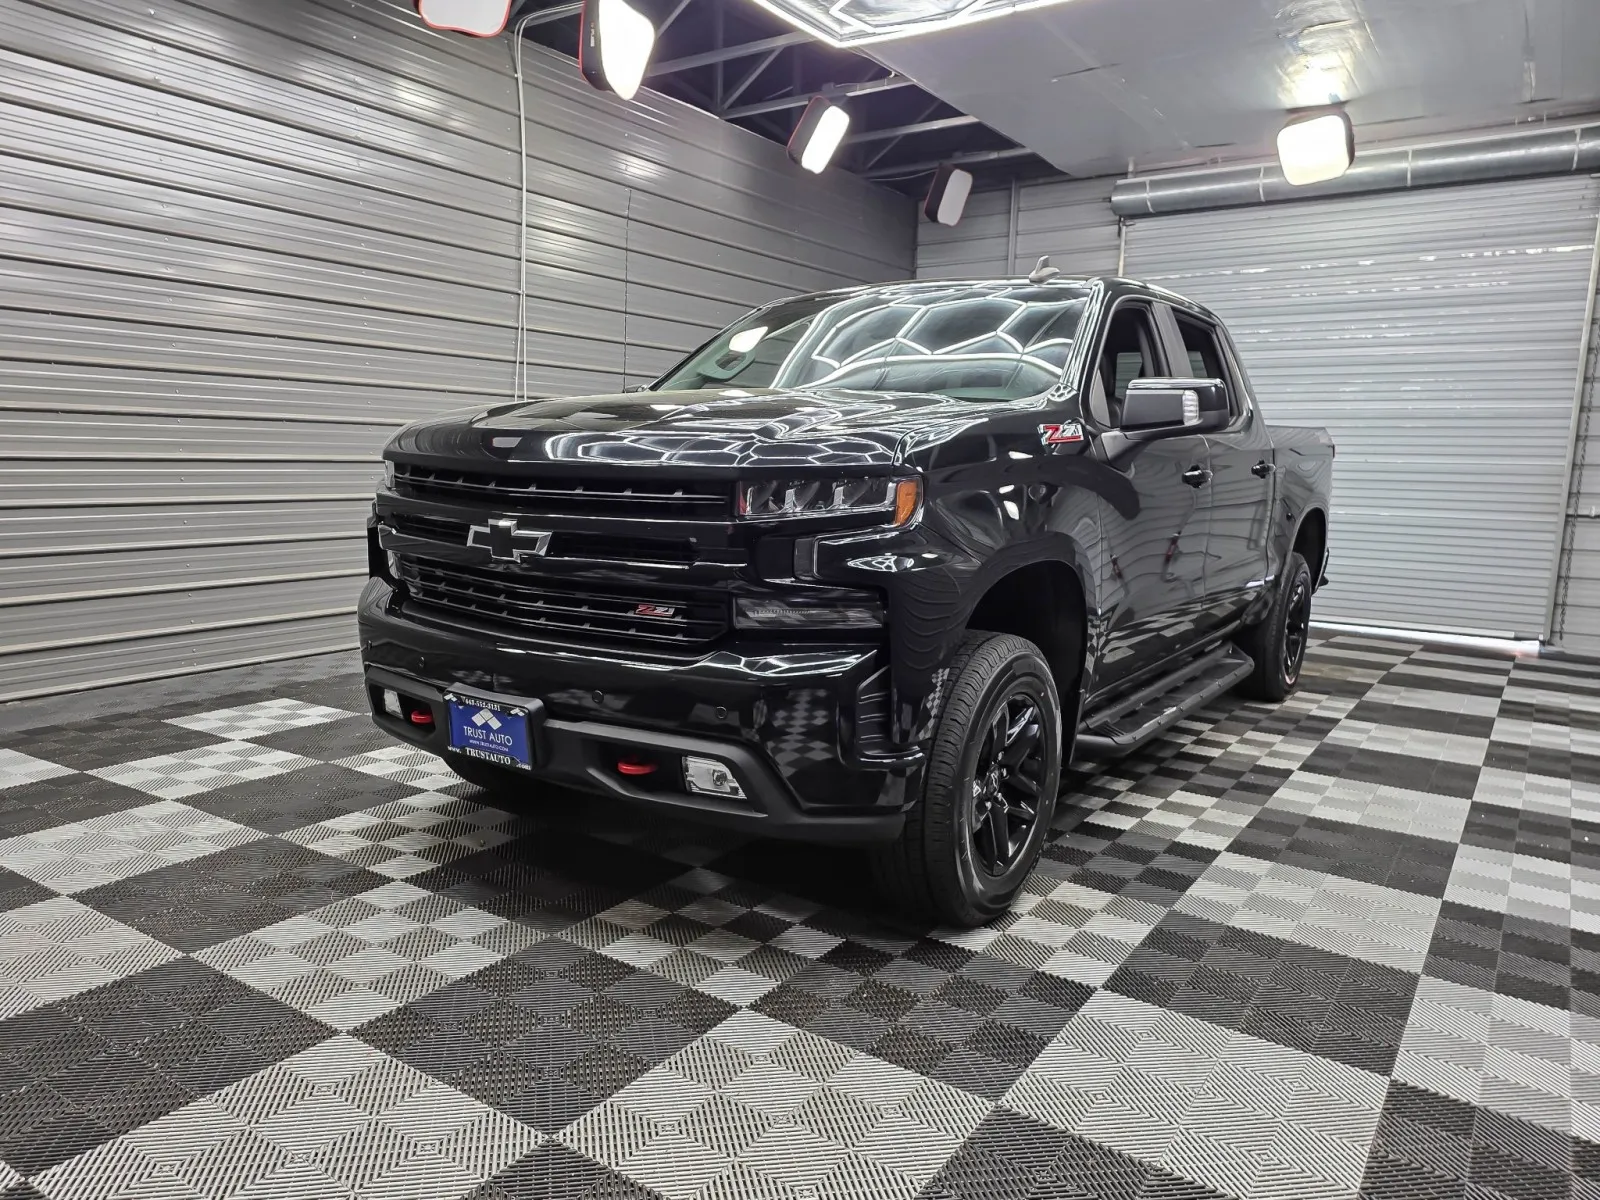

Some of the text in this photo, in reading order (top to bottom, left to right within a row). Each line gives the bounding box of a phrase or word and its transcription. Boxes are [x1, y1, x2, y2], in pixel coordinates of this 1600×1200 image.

[463, 726, 513, 746] TRUST AUTO
[465, 747, 511, 765] TRUSTAUTO
